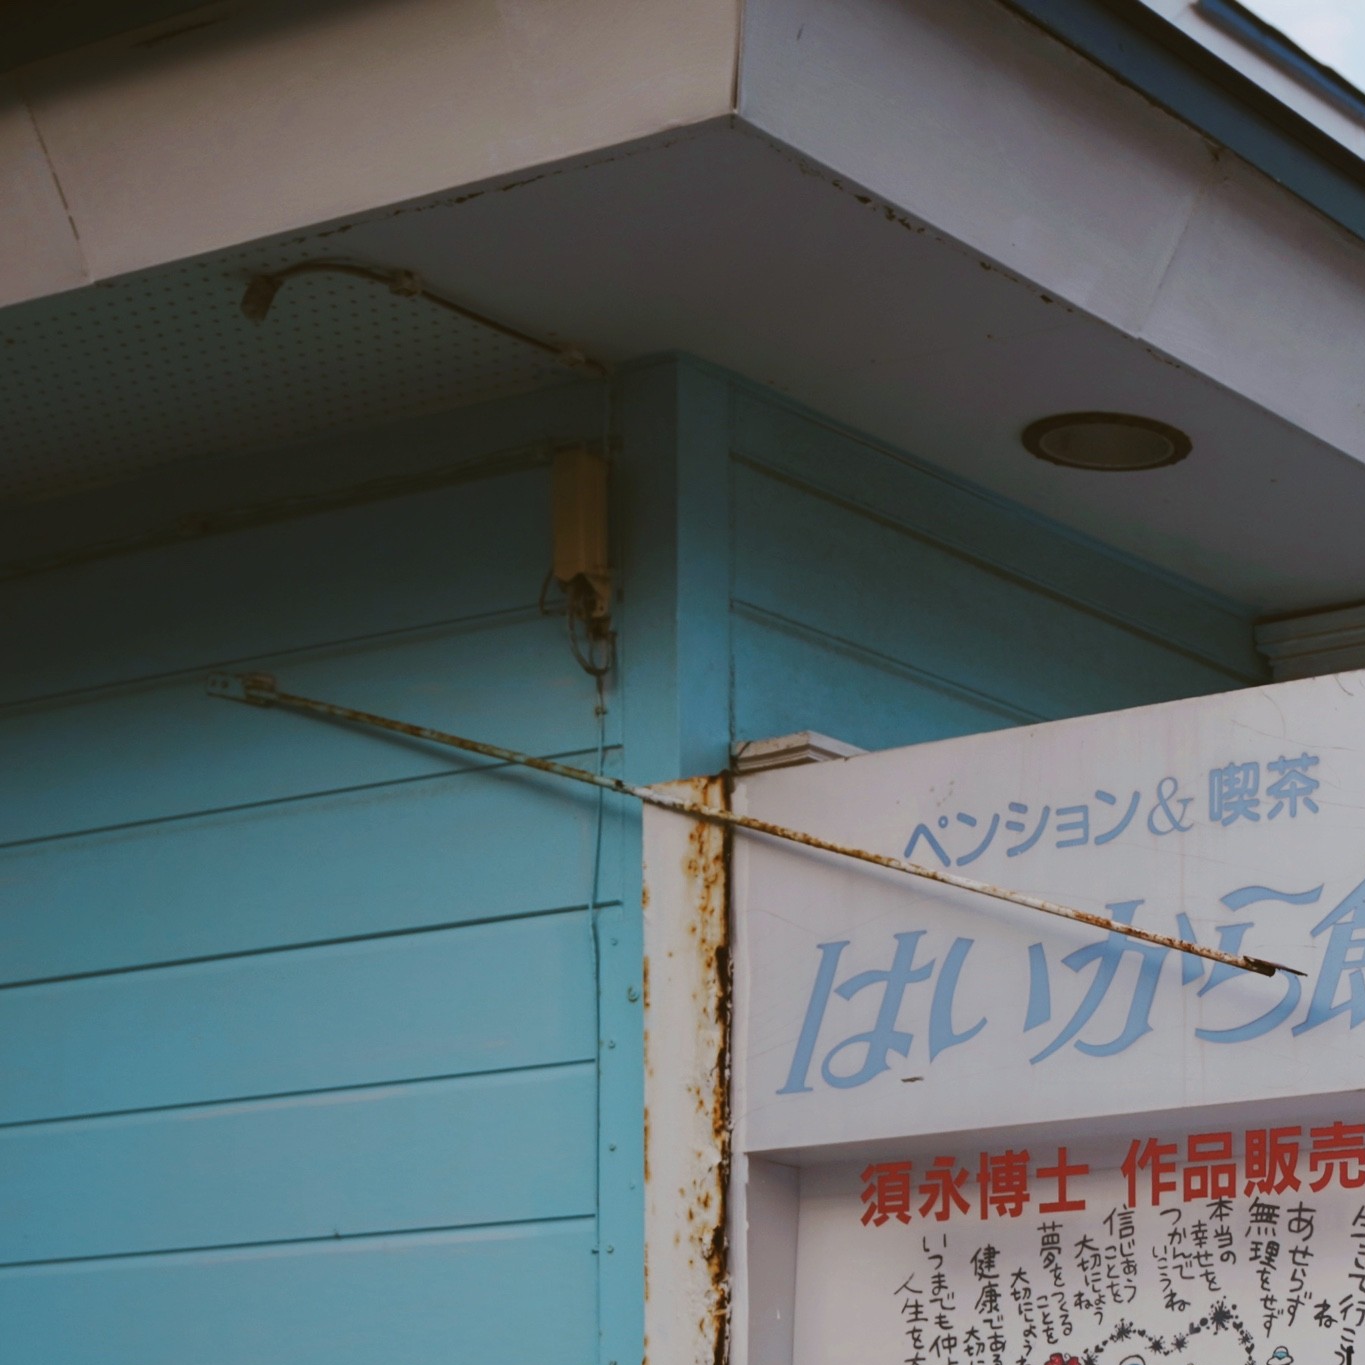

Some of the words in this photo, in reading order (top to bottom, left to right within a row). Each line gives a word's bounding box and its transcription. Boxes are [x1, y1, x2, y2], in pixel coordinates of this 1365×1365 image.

[859, 1147, 1091, 1227] 須永博士
[1103, 1203, 1138, 1304] 信じあう
[1159, 1207, 1195, 1280] つかんで
[1190, 1219, 1221, 1292] 幸せを
[1206, 1197, 1237, 1265] 本当の
[1245, 1196, 1284, 1339] 無理をせず
[1286, 1201, 1317, 1327] あせらず
[1036, 1221, 1073, 1337] 夢をつくる
[1104, 1244, 1125, 1304] ことを
[1036, 1295, 1059, 1345] ことを
